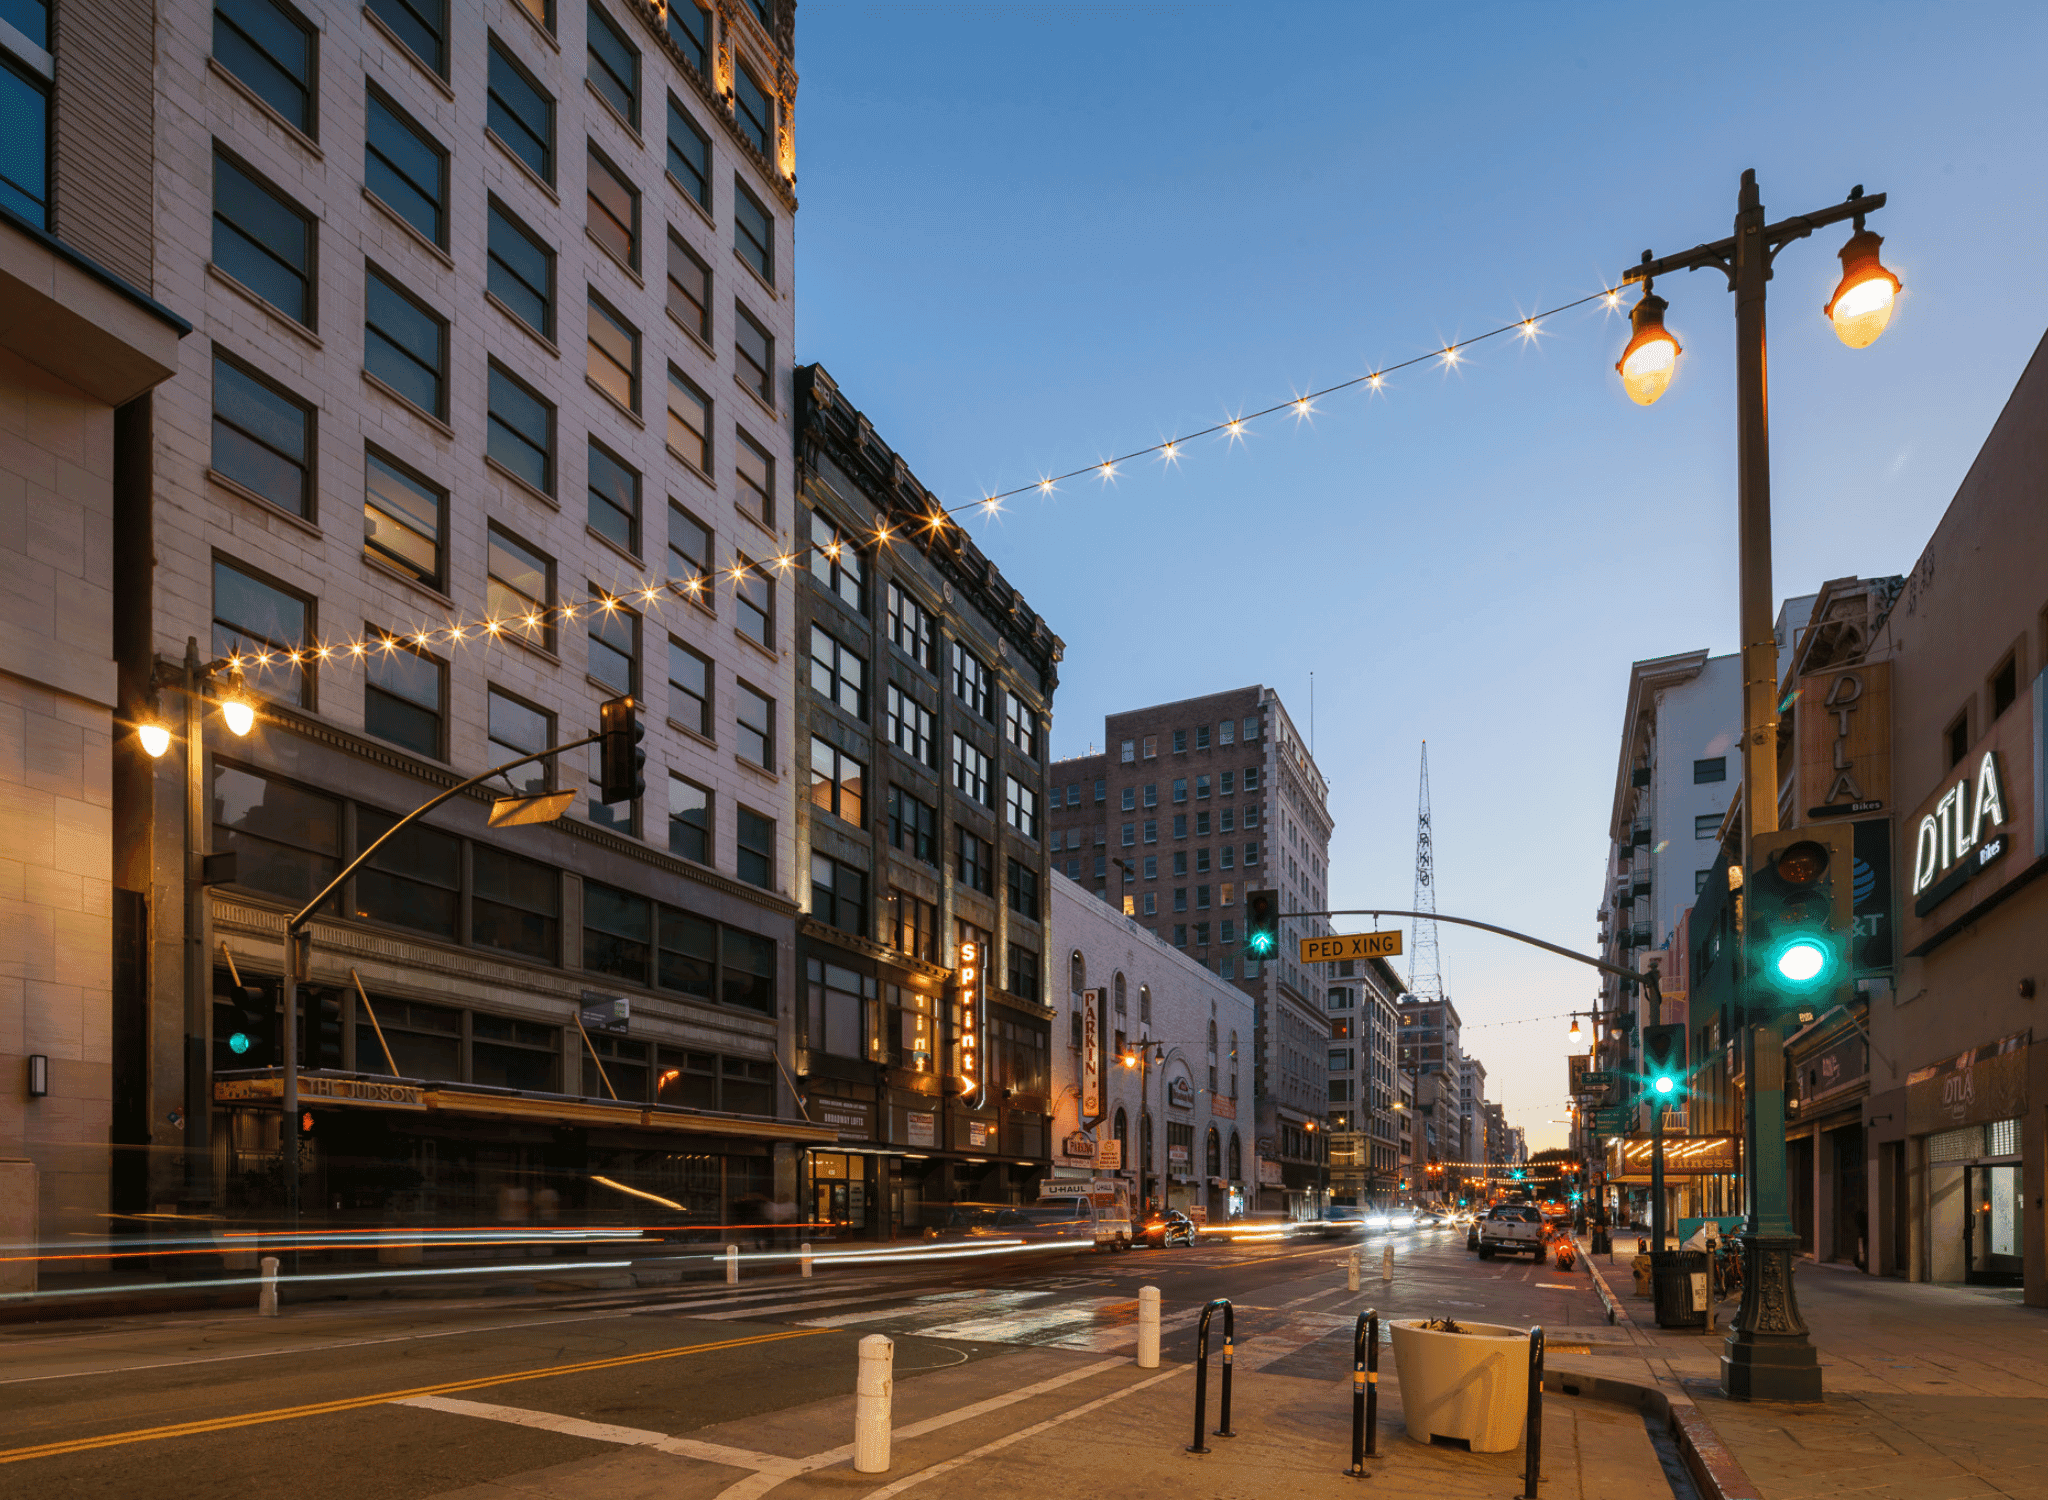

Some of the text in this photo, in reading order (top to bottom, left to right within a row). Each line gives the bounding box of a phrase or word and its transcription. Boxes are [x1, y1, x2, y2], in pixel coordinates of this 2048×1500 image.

[1824, 672, 1863, 804] DTLA
[1852, 801, 1880, 811] Bikes
[1913, 751, 2003, 896] DTLA
[1980, 840, 2001, 866] Bikes
[1309, 936, 1394, 958] PED XING
[961, 943, 975, 1070] Sprint
[1085, 993, 1097, 1089] PARKIN
[309, 1080, 418, 1103] THE JUDSON
[1944, 1066, 1975, 1104] DTLA
[824, 1113, 864, 1126] BROADWAY LOFTS
[1669, 1157, 1734, 1168] fitness
[1357, 1362, 1364, 1370] P
